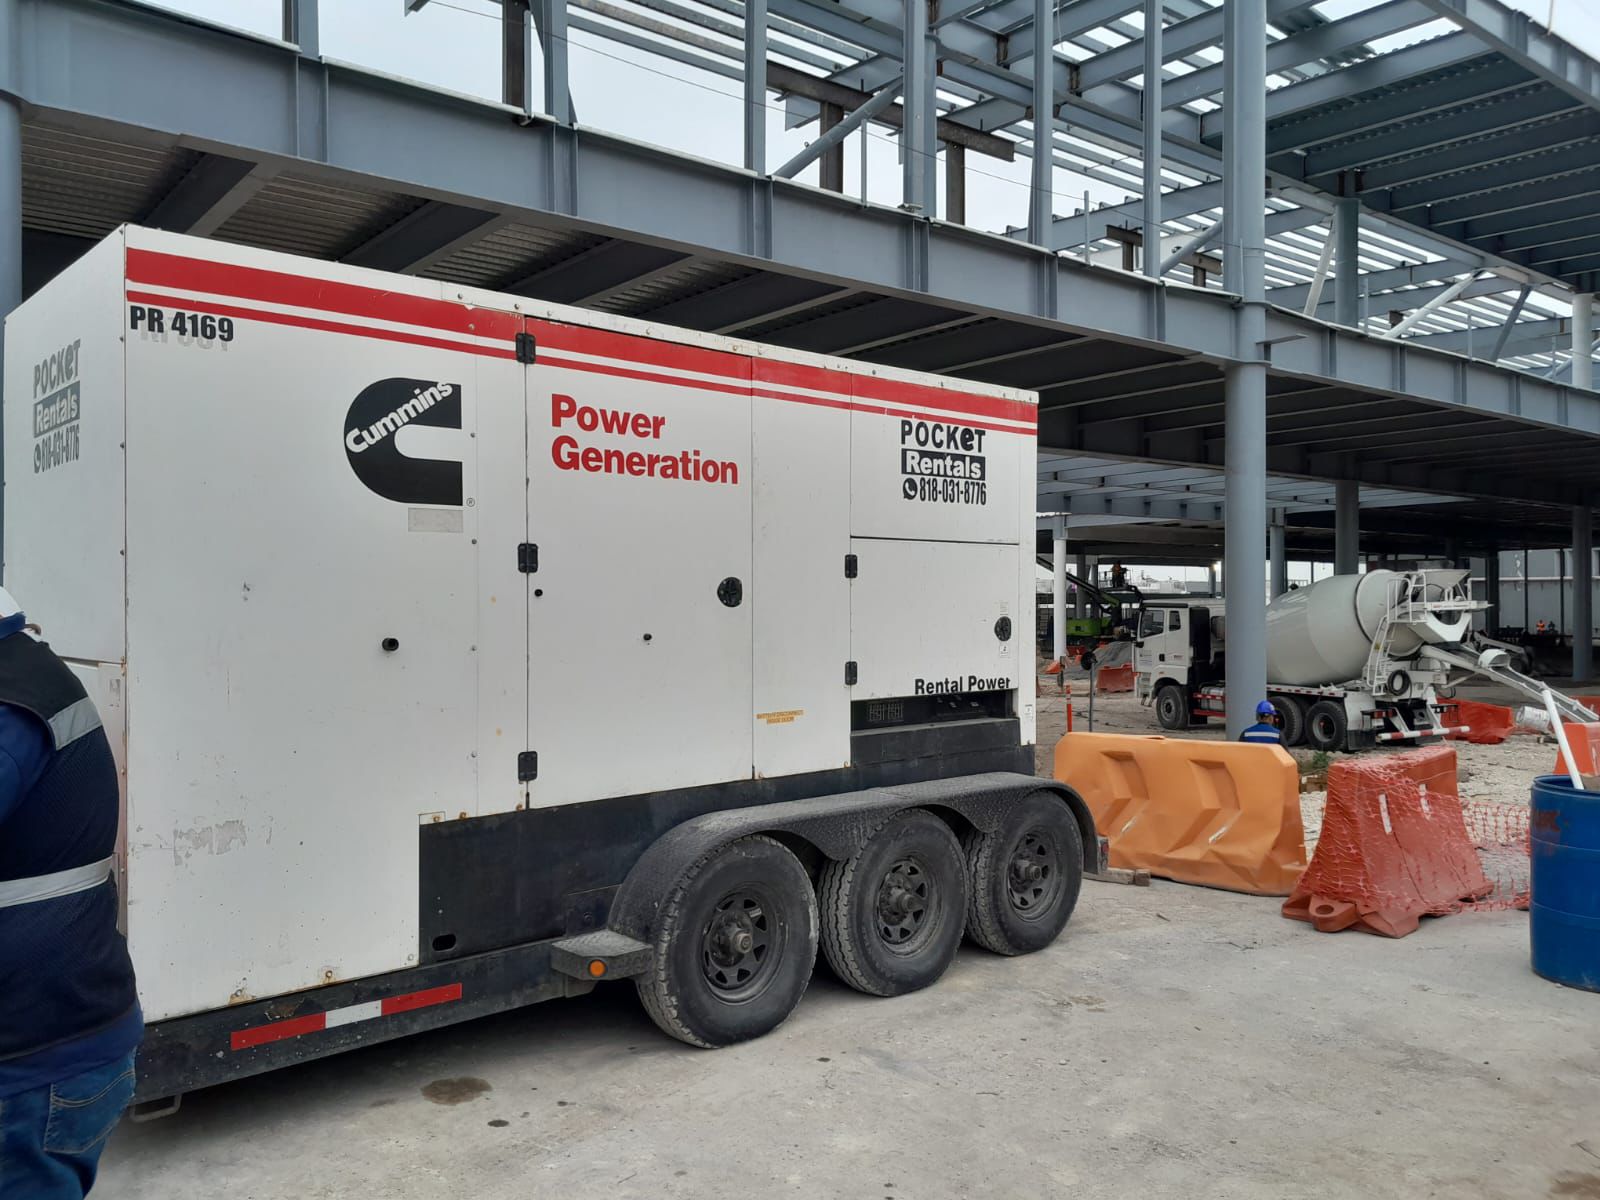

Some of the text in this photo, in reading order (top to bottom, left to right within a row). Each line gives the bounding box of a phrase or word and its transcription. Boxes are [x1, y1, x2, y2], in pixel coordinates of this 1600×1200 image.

[130, 305, 233, 342] PR 4169
[37, 387, 78, 433] Rentals
[345, 382, 453, 453] Cummins
[551, 393, 666, 439] Power
[551, 435, 738, 484] Generation
[905, 450, 982, 479] Rentals
[920, 477, 987, 506] 818-031-8776
[914, 675, 1011, 695] Rental Power
